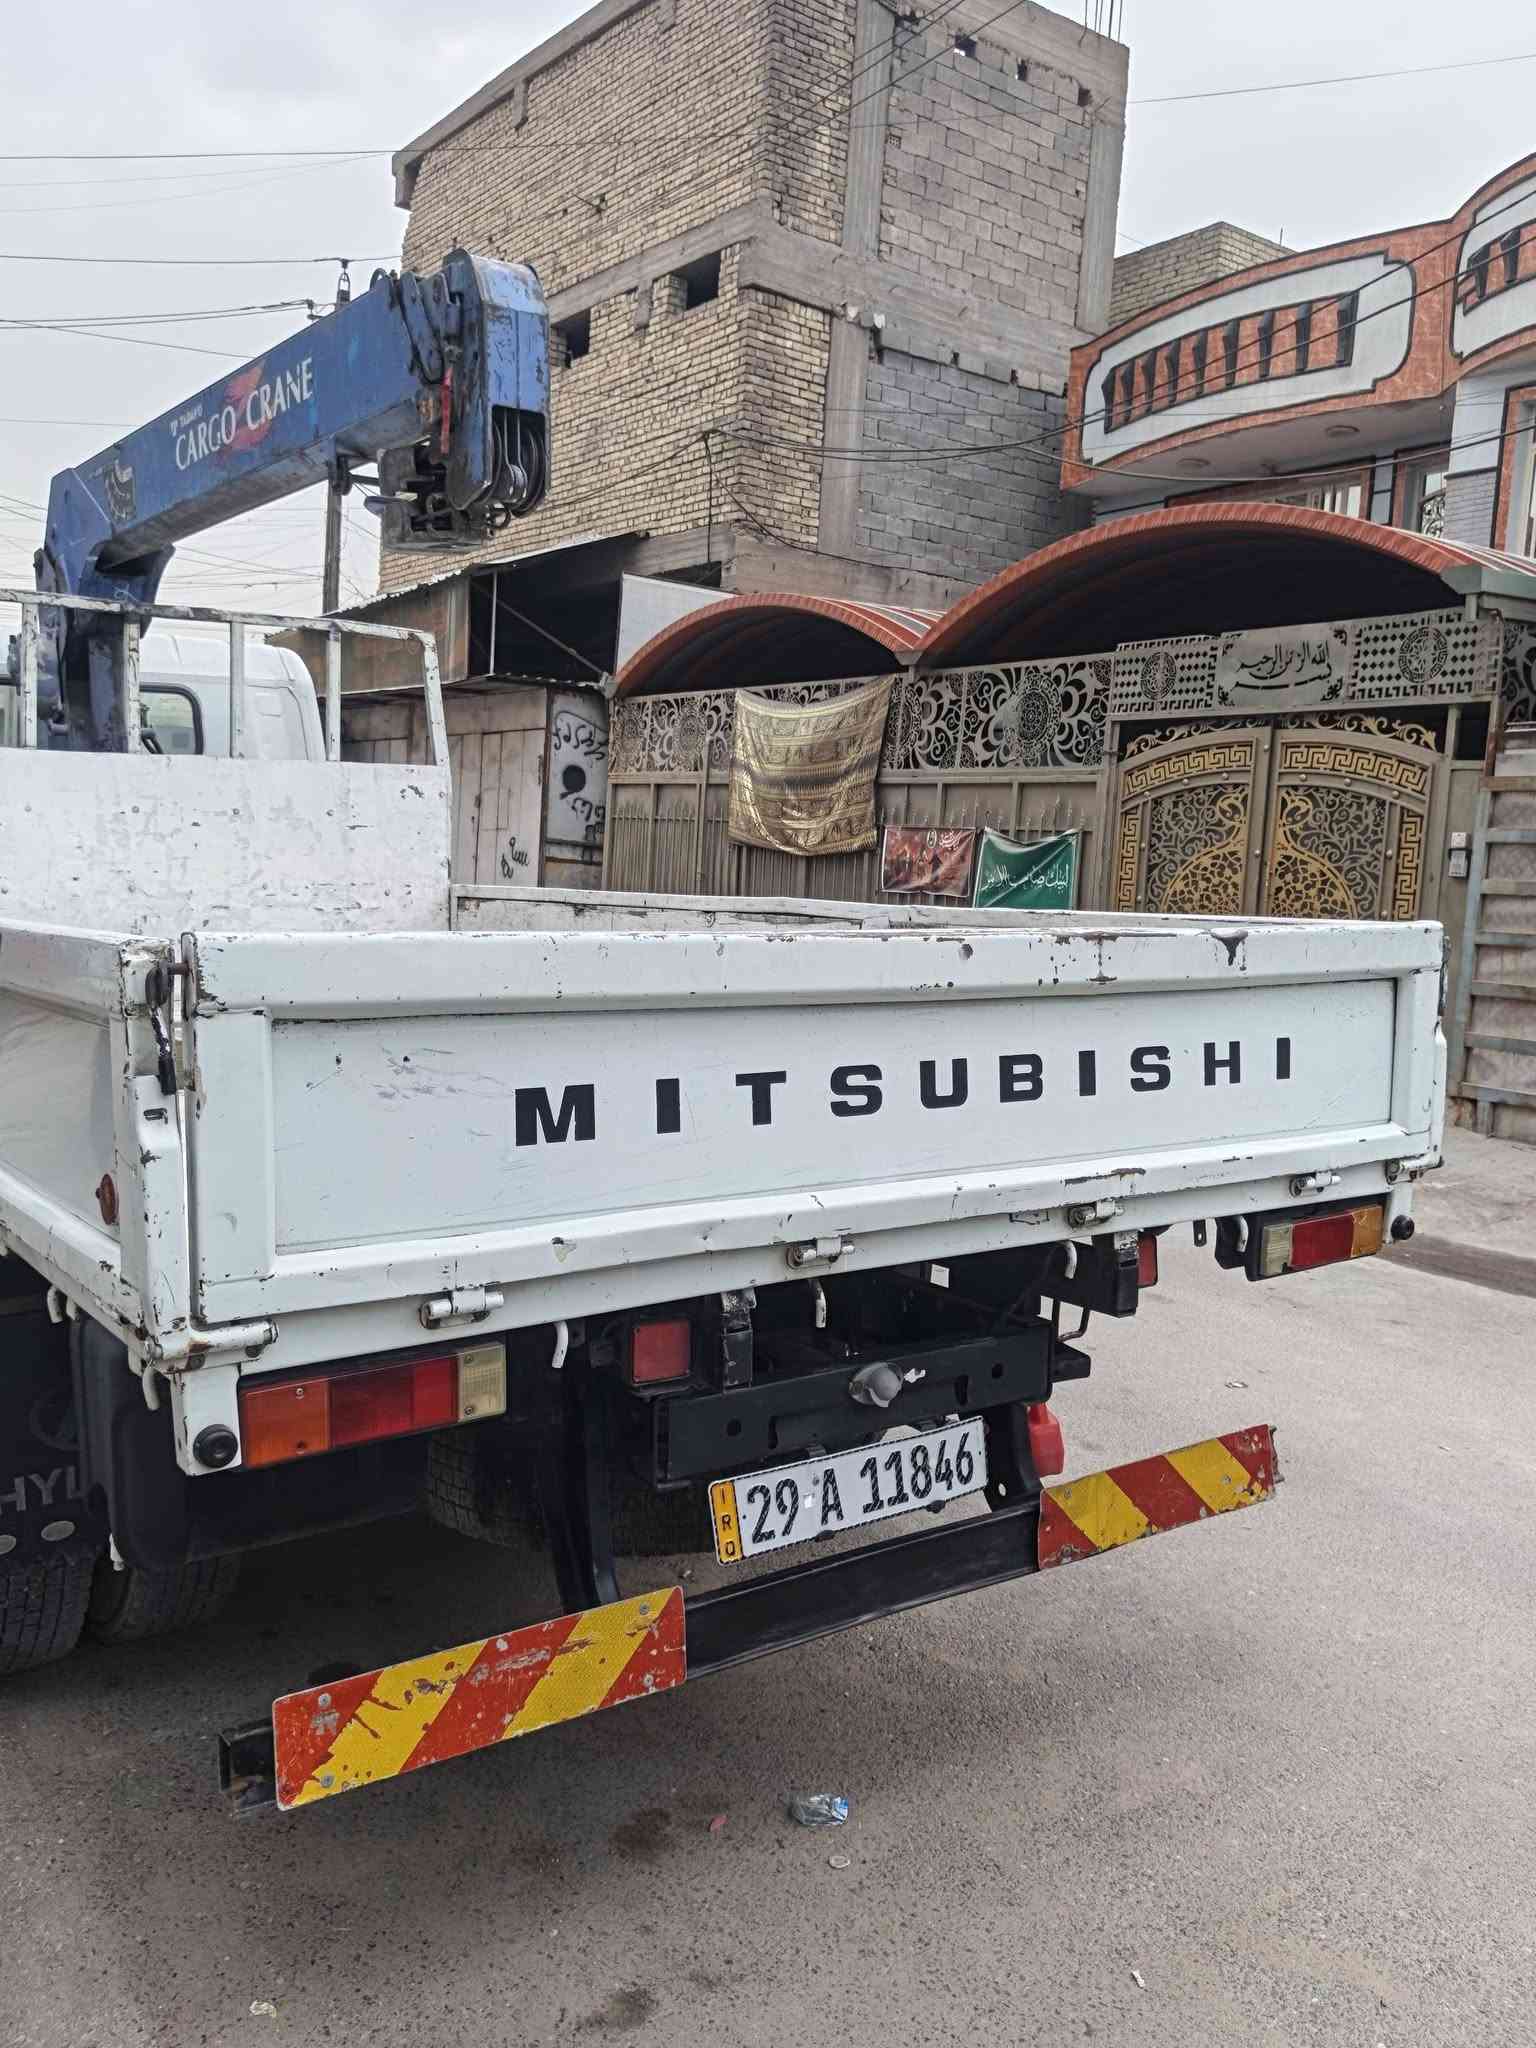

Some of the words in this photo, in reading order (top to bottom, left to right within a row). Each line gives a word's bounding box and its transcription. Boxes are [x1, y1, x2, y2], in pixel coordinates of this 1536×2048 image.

[175, 405, 236, 470] CARGO
[246, 357, 313, 430] CRANE
[515, 1037, 1290, 1146] MITSUBISHI
[747, 1478, 799, 1544] 29
[820, 1468, 844, 1526] A
[860, 1431, 974, 1514] 11846
